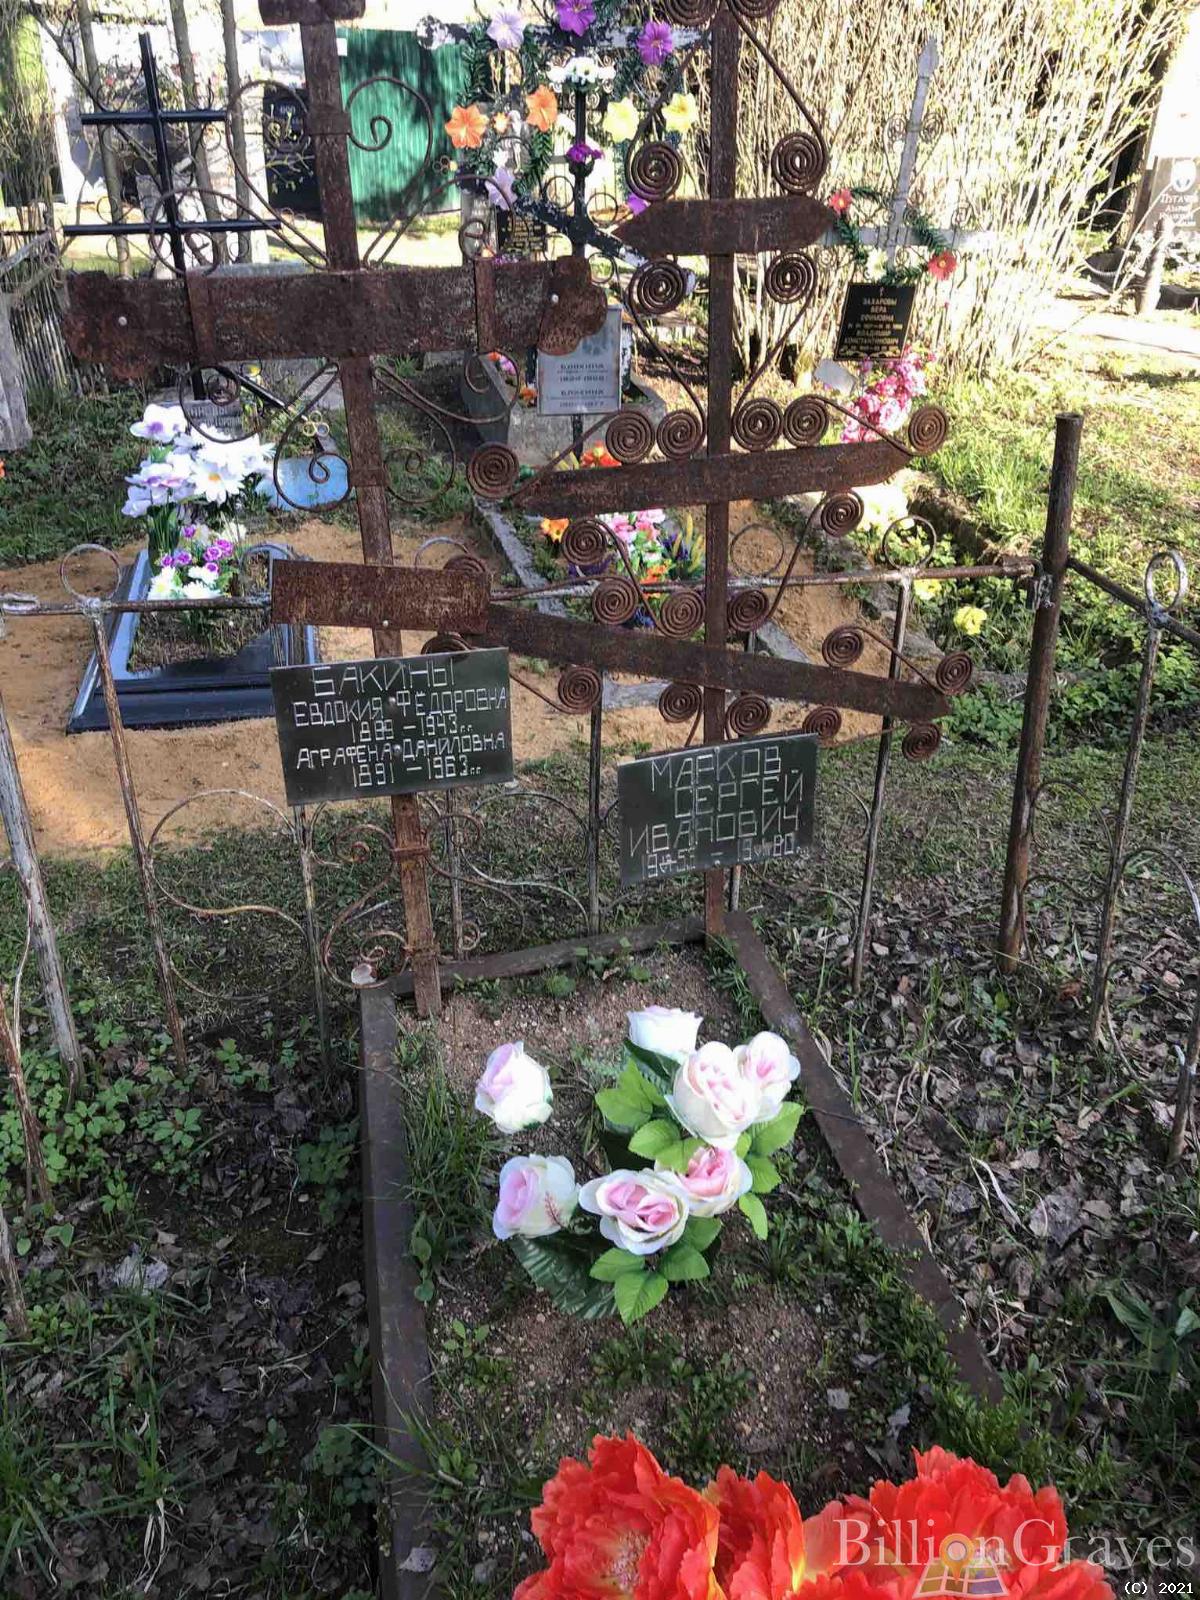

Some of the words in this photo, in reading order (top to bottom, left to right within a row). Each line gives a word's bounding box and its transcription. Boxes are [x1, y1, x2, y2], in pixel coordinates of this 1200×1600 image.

[312, 658, 455, 697] БАКИНЫ
[292, 696, 384, 727] ЕВДОКИЯ
[296, 742, 393, 770] АГРАФЕНА
[402, 732, 506, 763] ДАНИЛОВНА
[651, 745, 782, 792] МАРКОВ
[351, 761, 395, 789] 1891
[674, 769, 804, 819] СЕРГЕЙ
[629, 805, 799, 858] ИВАНОВИЧ
